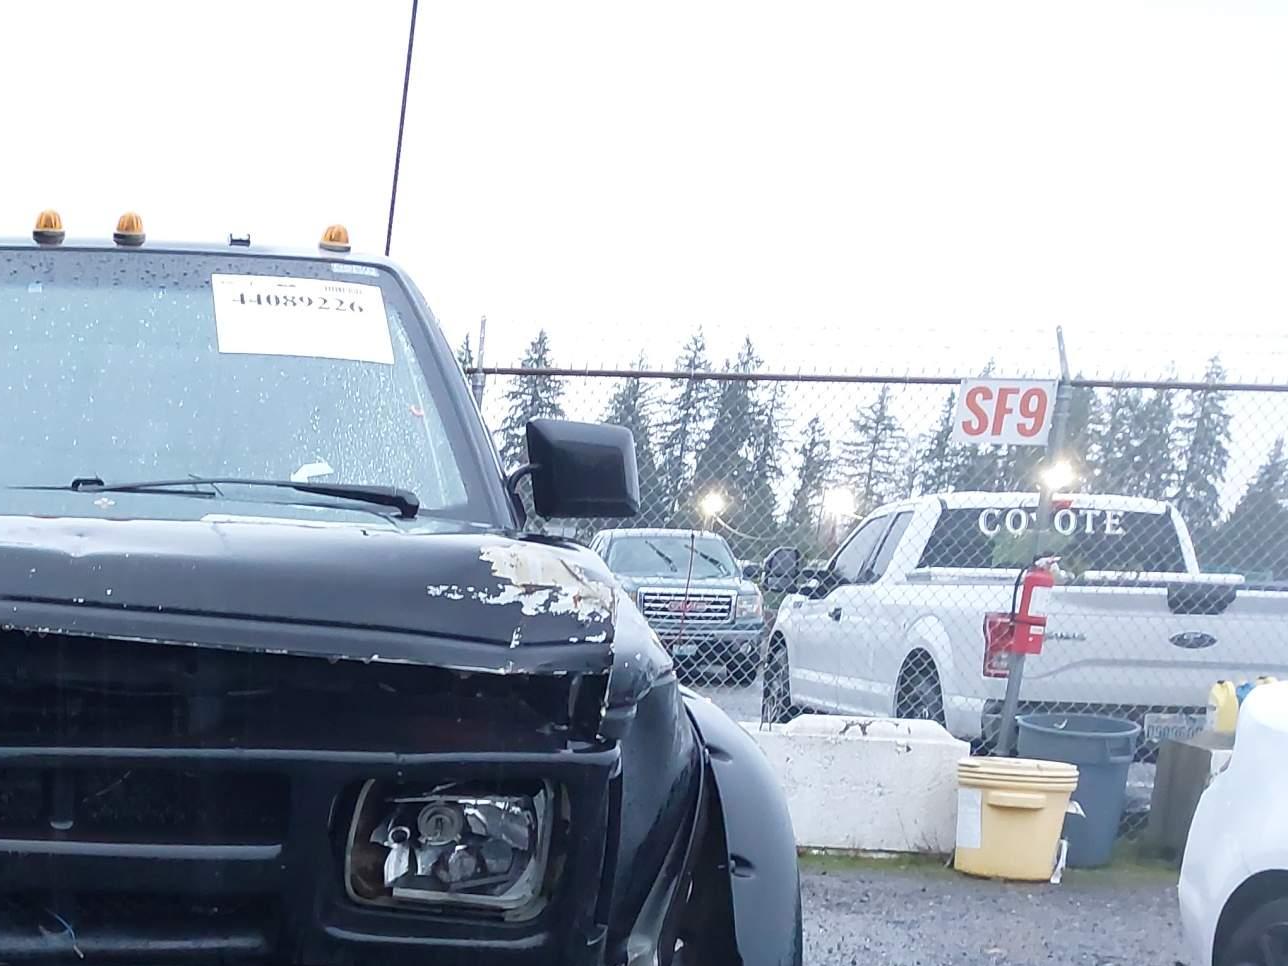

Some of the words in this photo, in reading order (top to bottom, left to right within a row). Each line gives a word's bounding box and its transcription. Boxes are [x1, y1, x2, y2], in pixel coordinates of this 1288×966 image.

[231, 292, 365, 313] 44089226
[961, 386, 1048, 438] SF9
[978, 508, 1127, 536] COOTE
